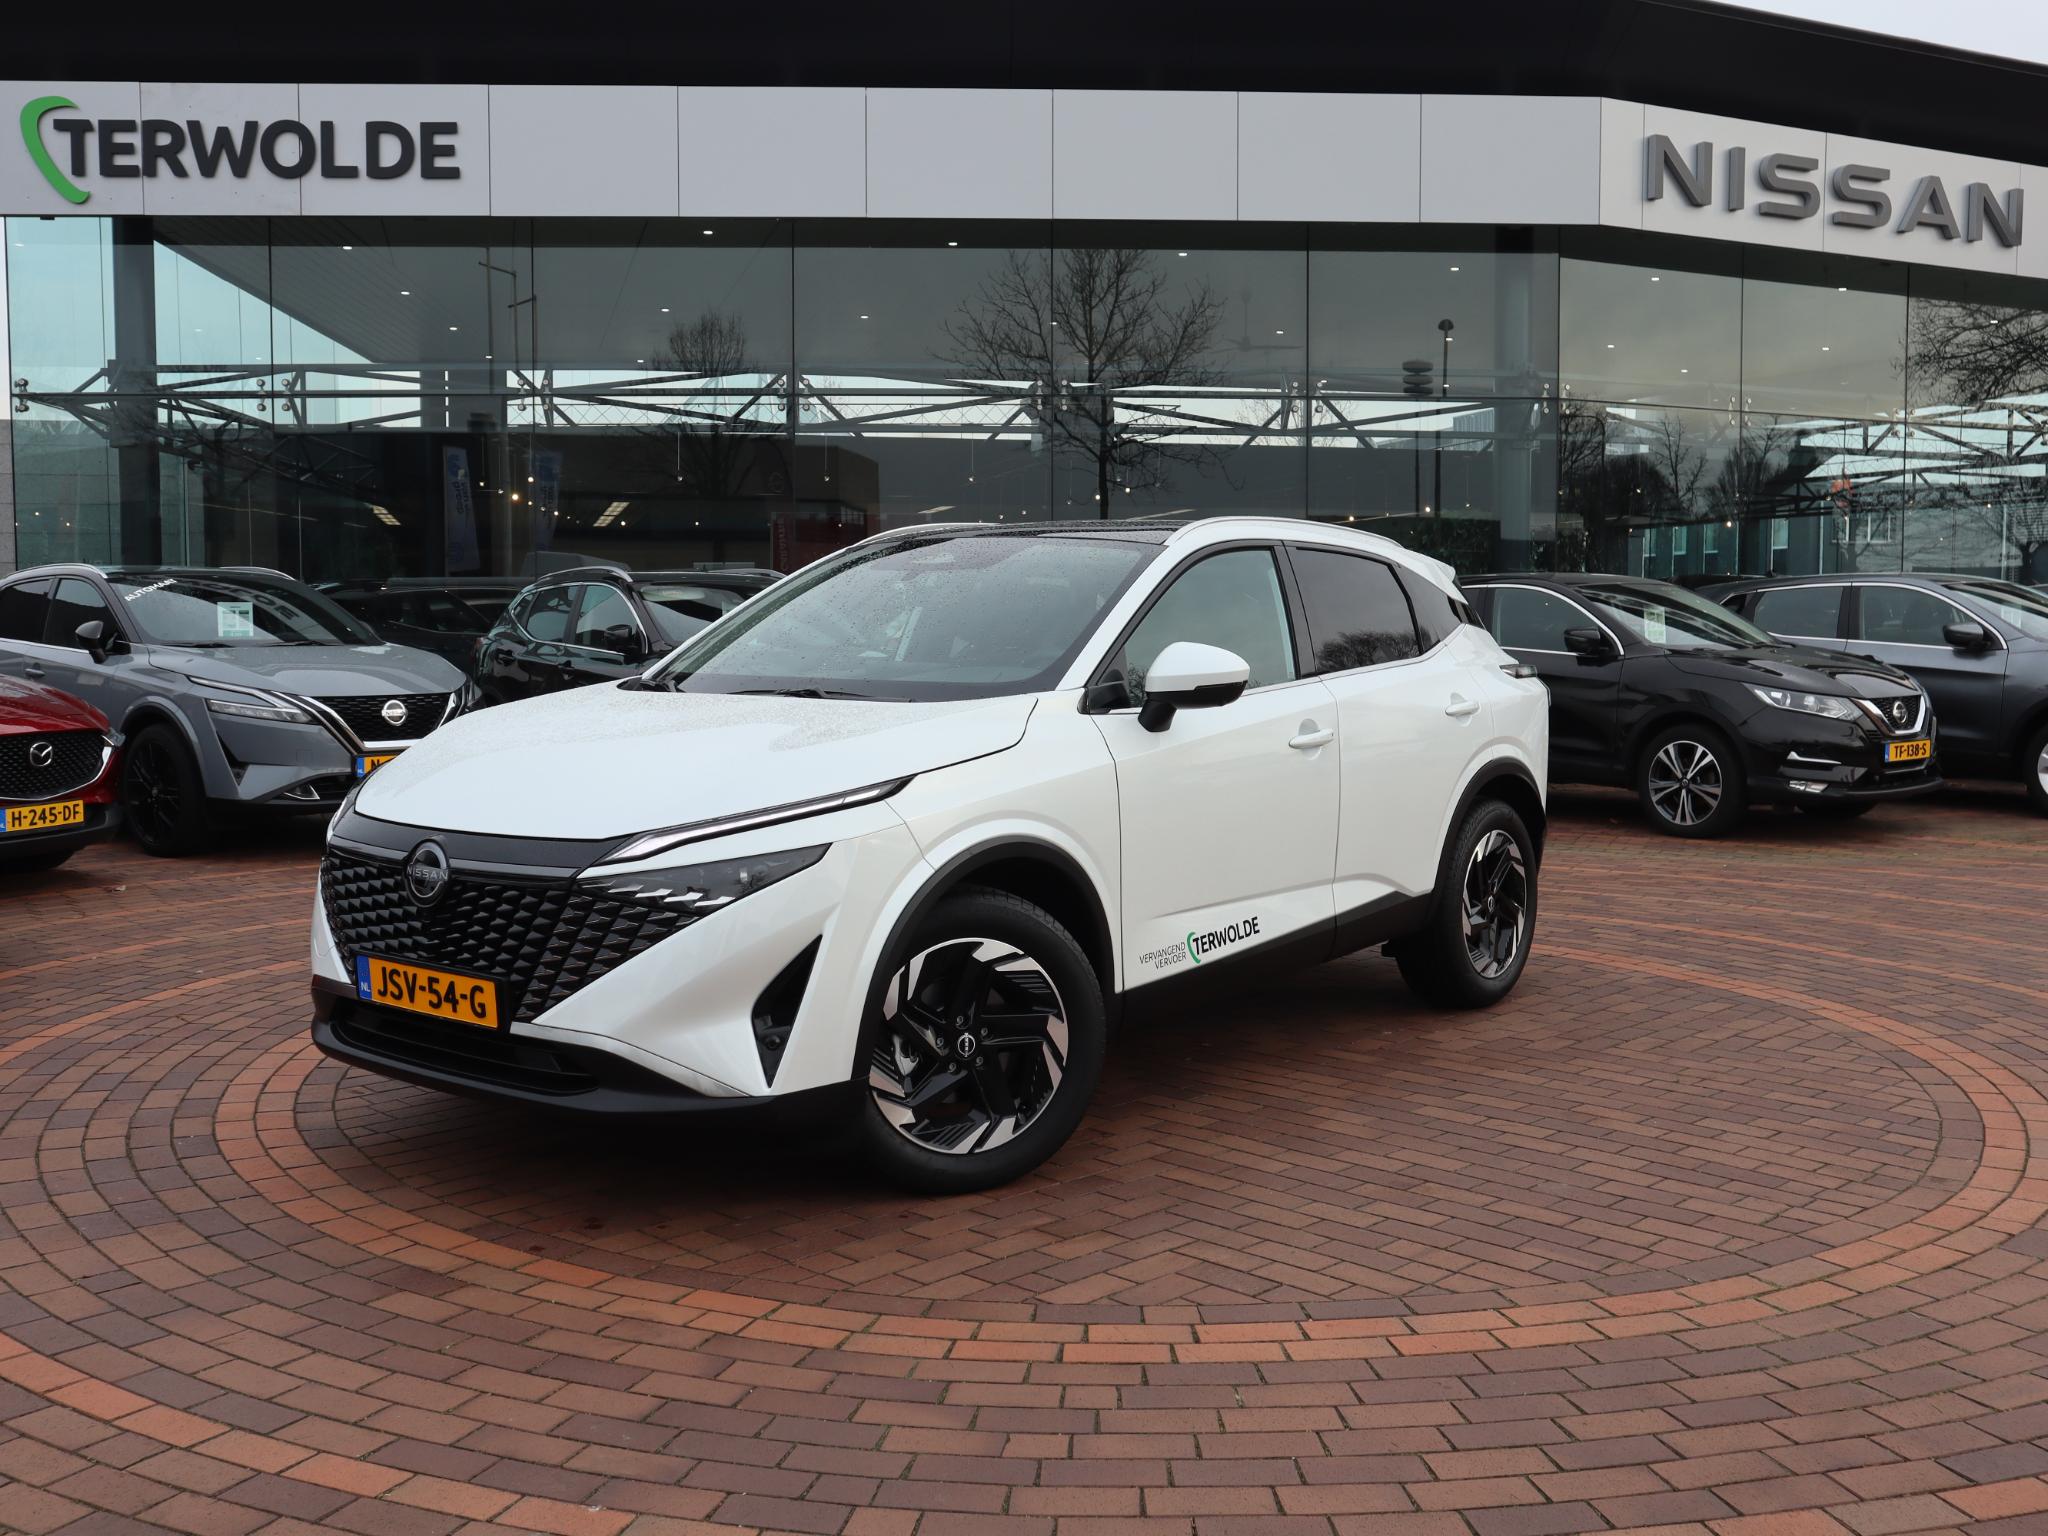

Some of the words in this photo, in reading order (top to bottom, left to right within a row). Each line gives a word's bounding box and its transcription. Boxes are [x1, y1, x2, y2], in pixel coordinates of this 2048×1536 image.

[53, 118, 461, 179] TERWOLDE
[1647, 134, 2024, 247] NISSAN
[1894, 743, 1927, 759] TF-138-S
[11, 803, 80, 828] H-245-DF
[407, 865, 448, 880] NISSAN
[1193, 916, 1260, 956] TERWOLDE
[1139, 941, 1186, 964] VERVANGEND
[1154, 952, 1187, 970] VERVOER
[377, 966, 487, 1019] JSV-54-G
